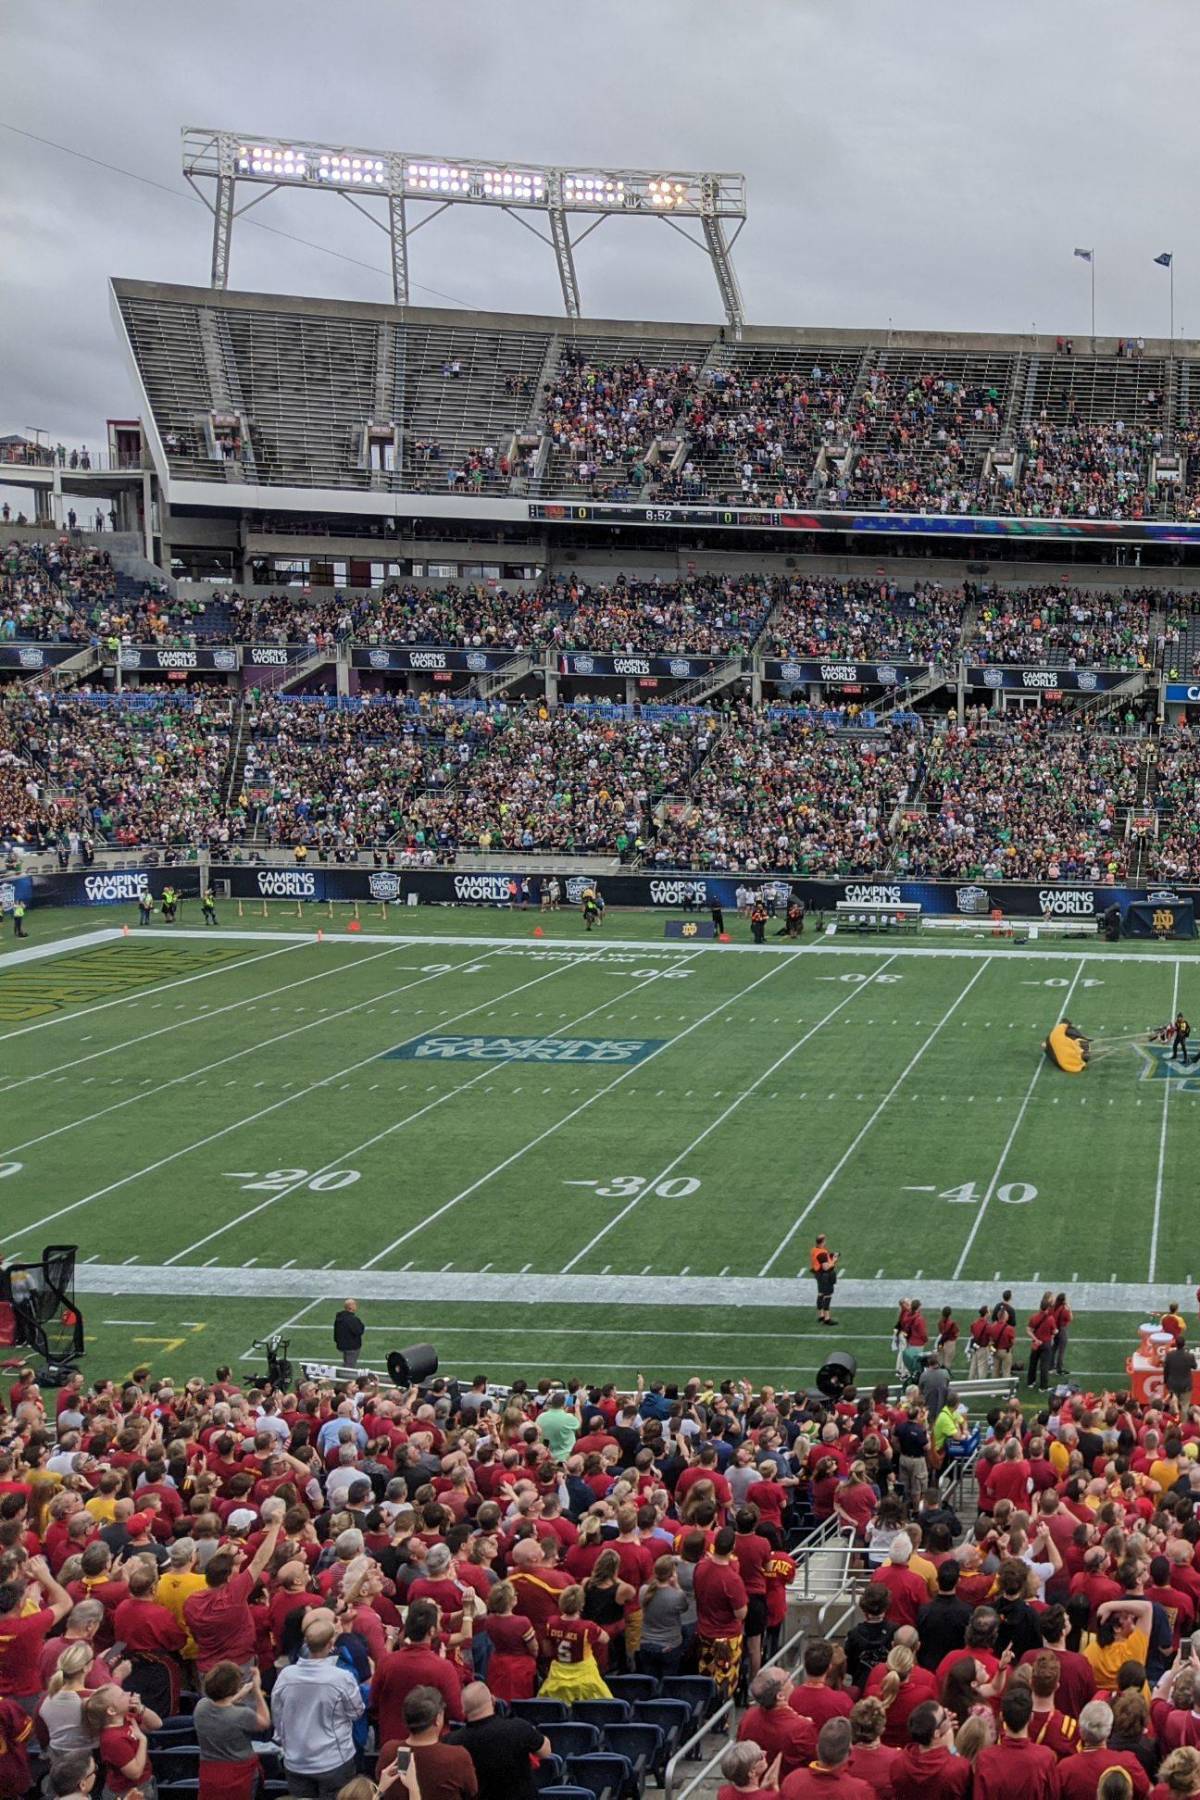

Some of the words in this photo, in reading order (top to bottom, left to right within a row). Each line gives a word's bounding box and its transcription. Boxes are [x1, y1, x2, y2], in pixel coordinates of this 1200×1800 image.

[578, 508, 586, 518] 0
[646, 511, 672, 521] 8:52
[724, 512, 732, 523] 0
[157, 651, 197, 659] CAMPING
[252, 648, 288, 657] CAMPING
[158, 658, 197, 667] WORLD
[252, 656, 288, 664] WORLD
[410, 660, 446, 668] WORLD
[614, 666, 650, 674] WORLD
[820, 665, 857, 673] CAMPING
[821, 673, 857, 681] WORLD
[1023, 679, 1058, 687] WORLD
[84, 874, 148, 888] CAMPING
[258, 872, 314, 883] CAMPING
[454, 876, 510, 887] CAMPING
[258, 882, 315, 895] WORLD
[455, 886, 510, 899] WORLD
[845, 885, 900, 896] CAMPING
[1039, 890, 1094, 902] CAMPING
[1040, 902, 1094, 913] WORLD
[425, 1037, 644, 1051] CAMPING
[414, 1046, 634, 1061] WORLD
[240, 1168, 362, 1191] 20
[595, 1176, 702, 1198] 30
[937, 1181, 1038, 1203] 40
[1143, 1375, 1165, 1399] G
